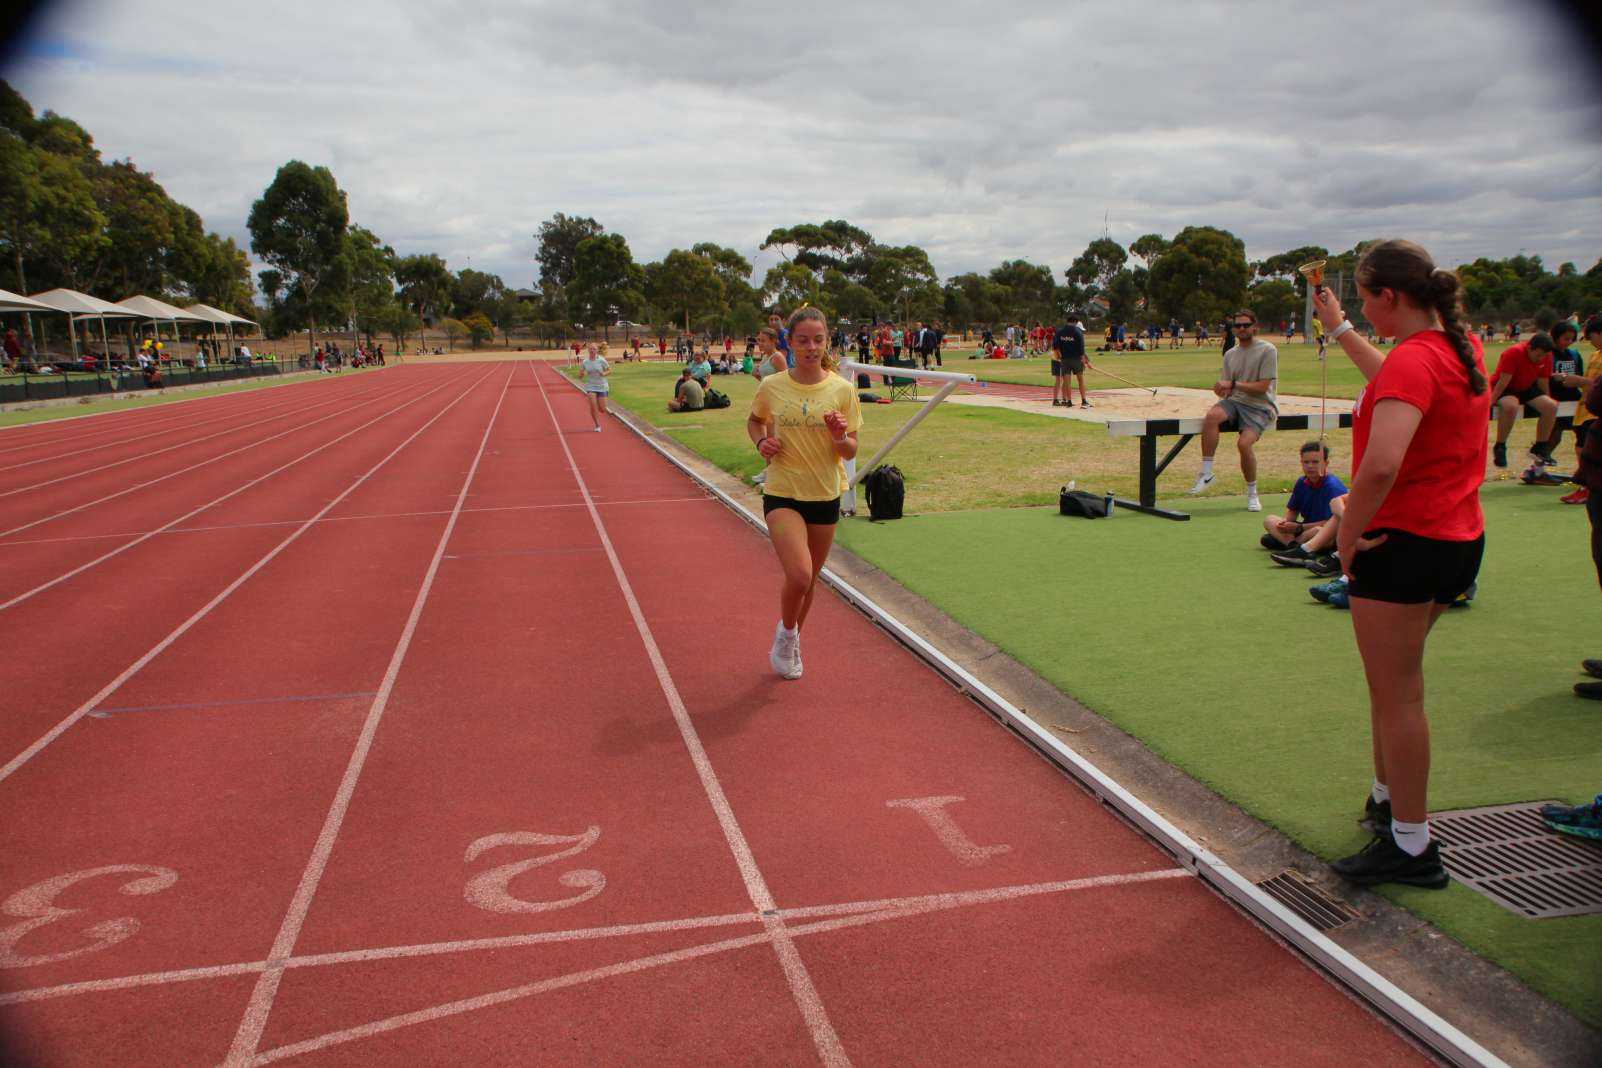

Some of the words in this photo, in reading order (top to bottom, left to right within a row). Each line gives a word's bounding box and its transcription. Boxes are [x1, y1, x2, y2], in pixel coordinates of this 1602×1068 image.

[464, 825, 606, 914] 2
[885, 795, 1012, 866] 1
[0, 863, 179, 969] 3
